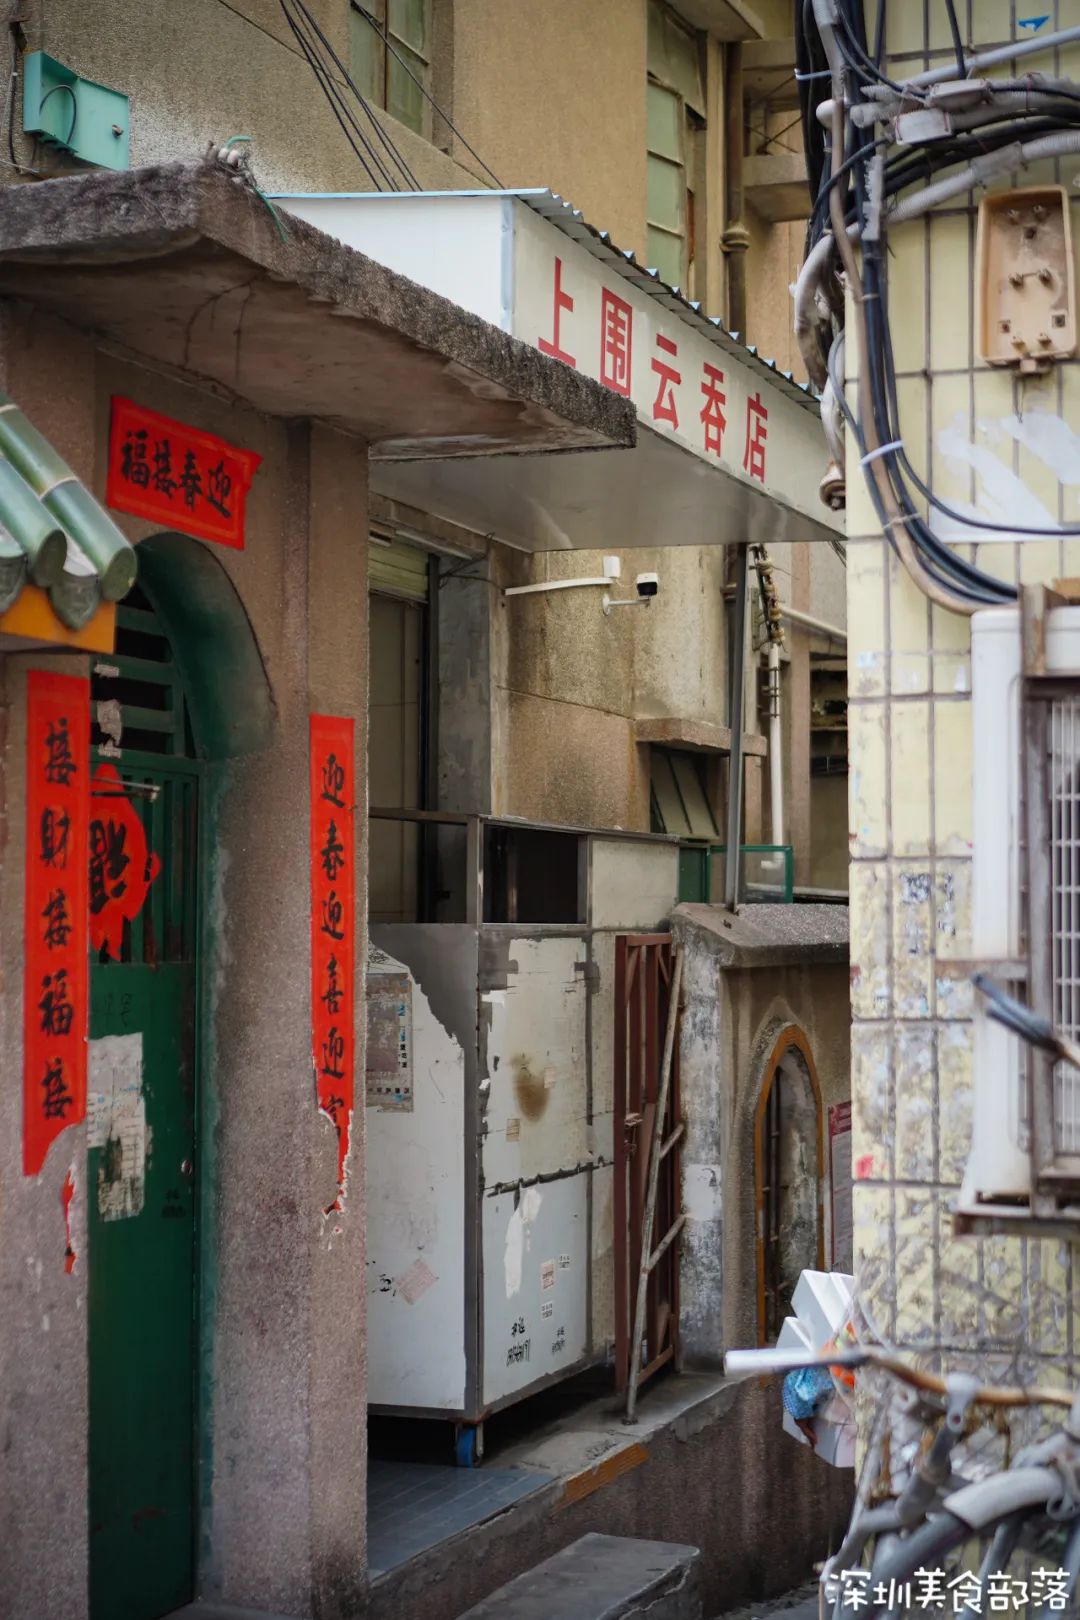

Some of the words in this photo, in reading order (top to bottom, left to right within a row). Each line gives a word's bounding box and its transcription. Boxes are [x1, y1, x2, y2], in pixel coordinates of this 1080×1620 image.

[538, 256, 768, 484] 上围云吞店
